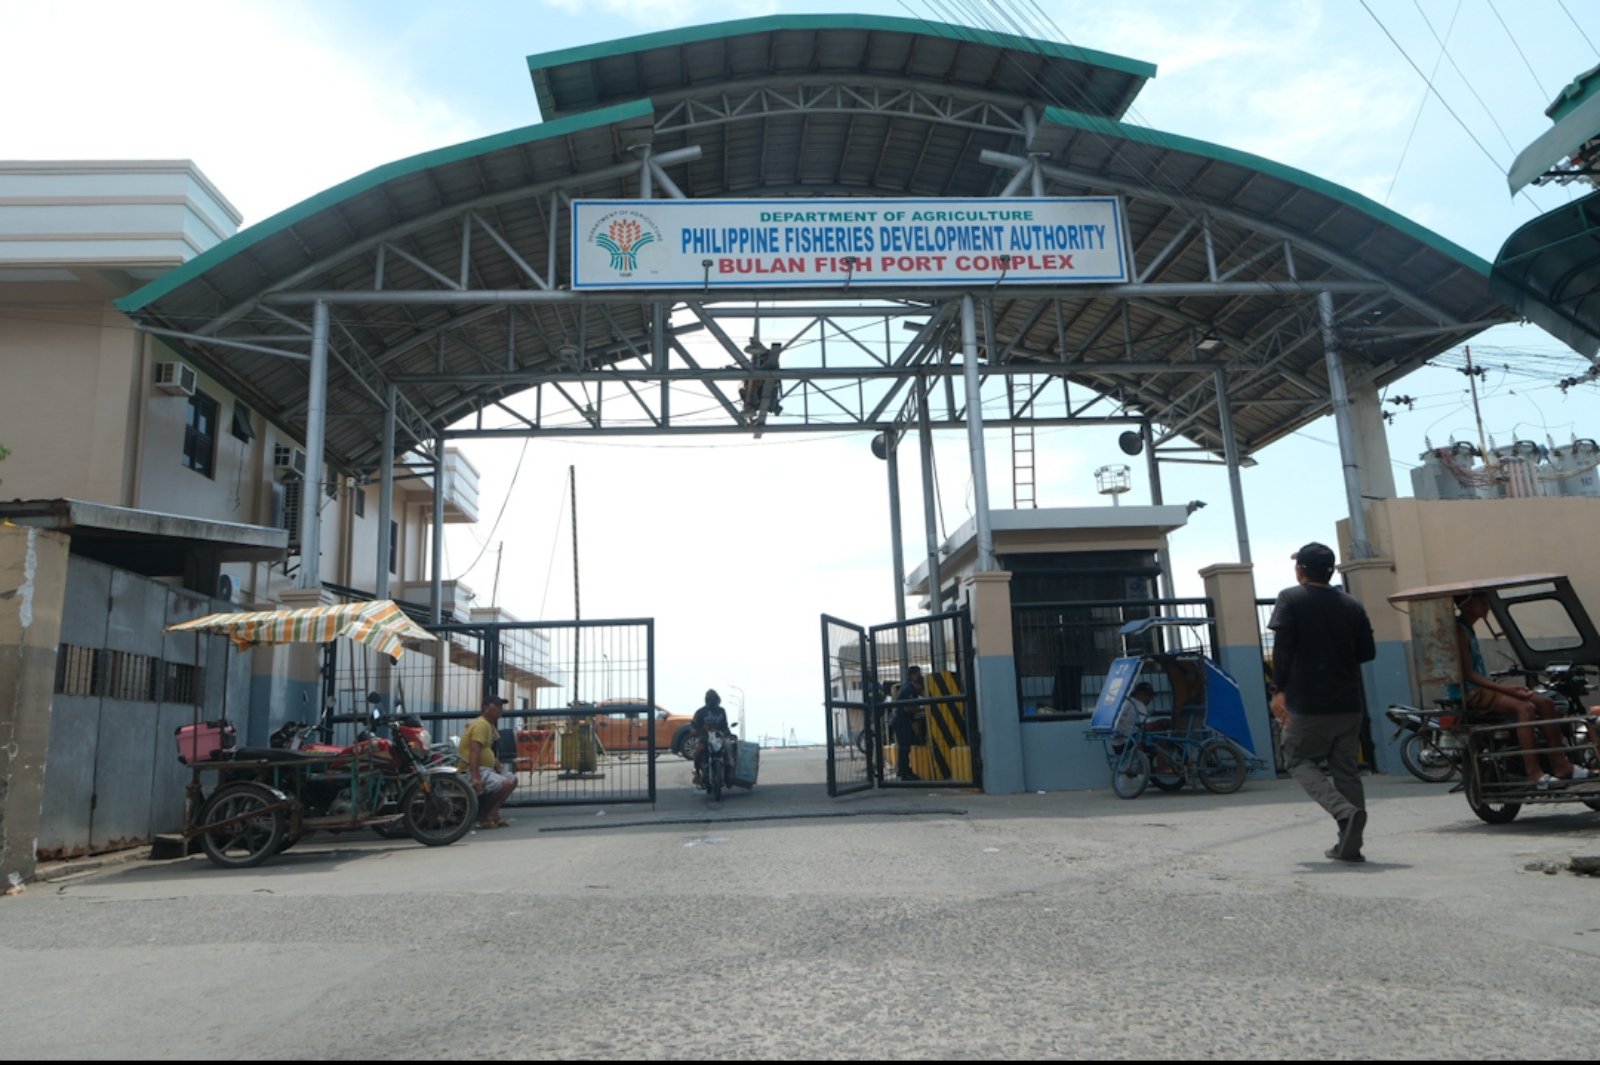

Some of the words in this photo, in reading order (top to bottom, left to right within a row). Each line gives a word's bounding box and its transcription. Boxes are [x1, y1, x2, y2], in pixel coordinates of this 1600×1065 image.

[760, 212, 877, 223] DEPARTMENT
[883, 211, 905, 222] OF
[911, 210, 1033, 222] AGRICULTURE
[681, 227, 779, 254] PHILIPPINE
[785, 226, 875, 252] FISHERIES
[880, 225, 1004, 252] DEVELOPMENT
[1010, 224, 1106, 251] AUTHORITY
[718, 257, 805, 274] BULAN
[815, 256, 872, 273] FISH
[881, 256, 947, 272] PORT
[955, 254, 1075, 271] COMPLEX
